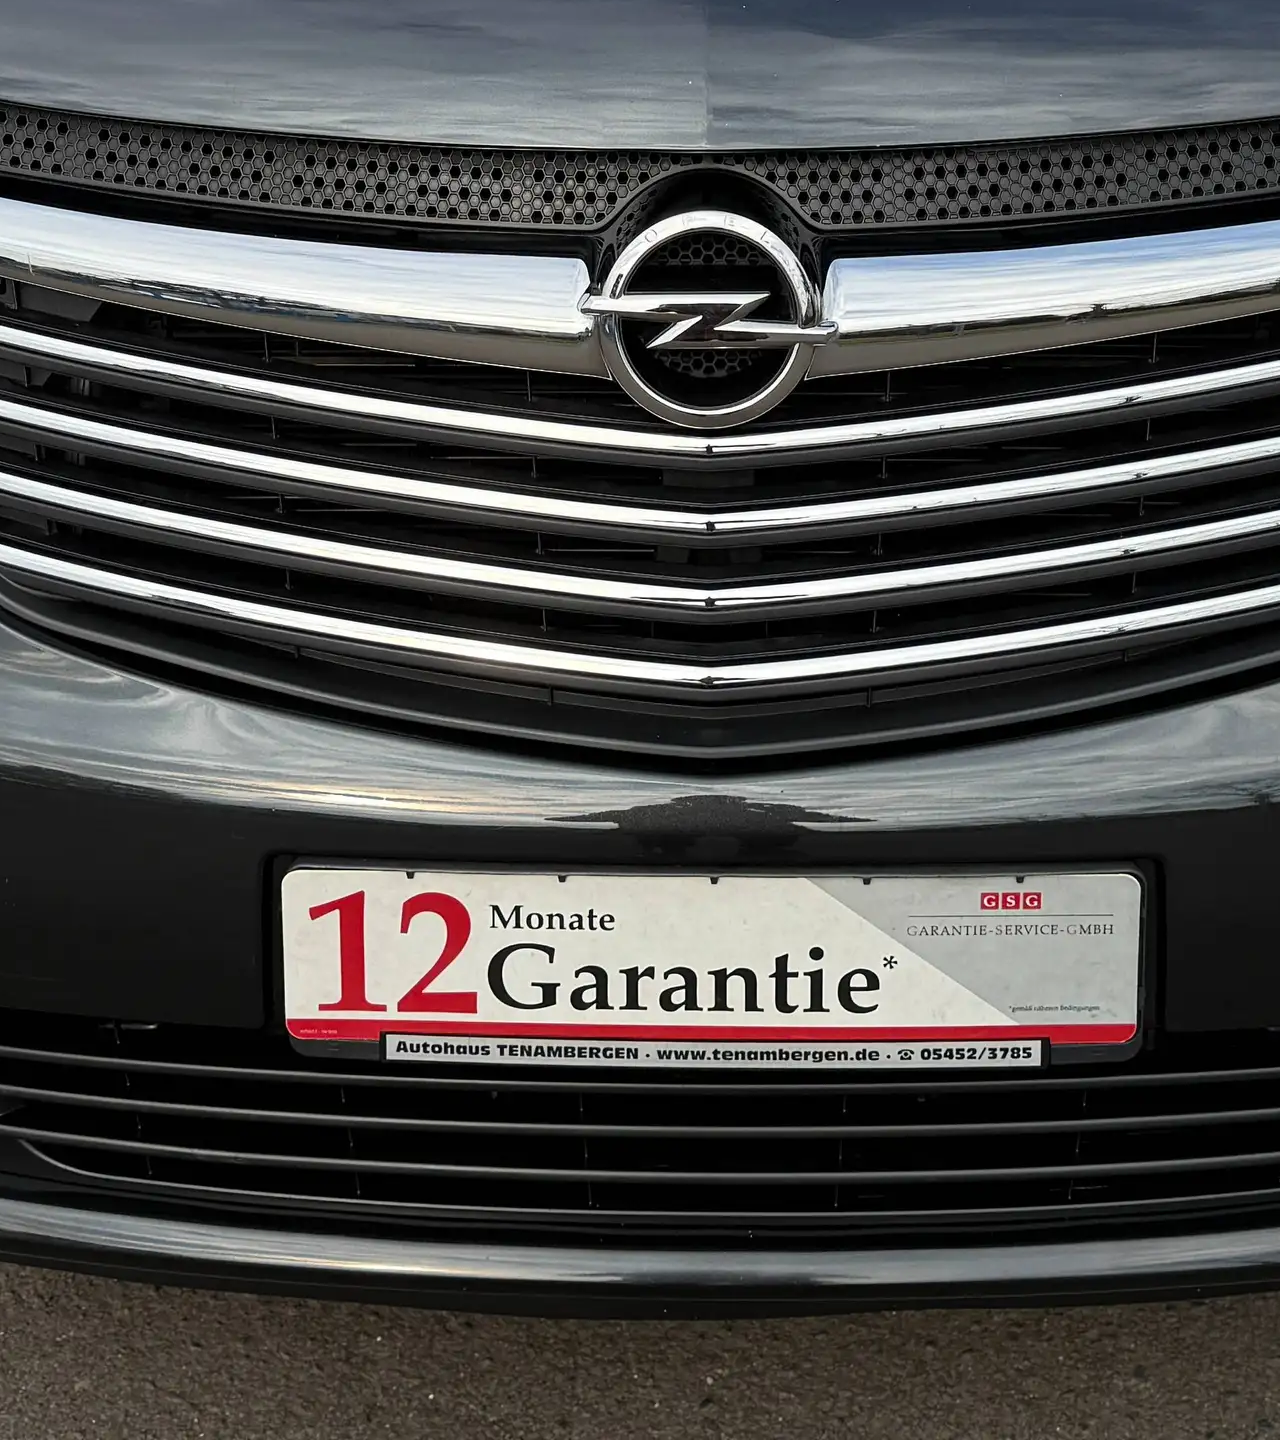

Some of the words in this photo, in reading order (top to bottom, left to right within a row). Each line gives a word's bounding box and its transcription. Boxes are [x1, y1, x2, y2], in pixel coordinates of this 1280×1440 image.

[982, 894, 1040, 908] GSG
[907, 924, 1114, 937] GARANTIE-SERVICE-GMBH
[308, 890, 478, 1014] 12
[489, 904, 615, 931] Monate
[395, 1040, 490, 1057] Autohaus
[497, 1044, 639, 1060] TENAMBERGEN
[656, 1047, 880, 1064] www.tenambergen.de
[920, 1046, 1033, 1062] 05452/3785
